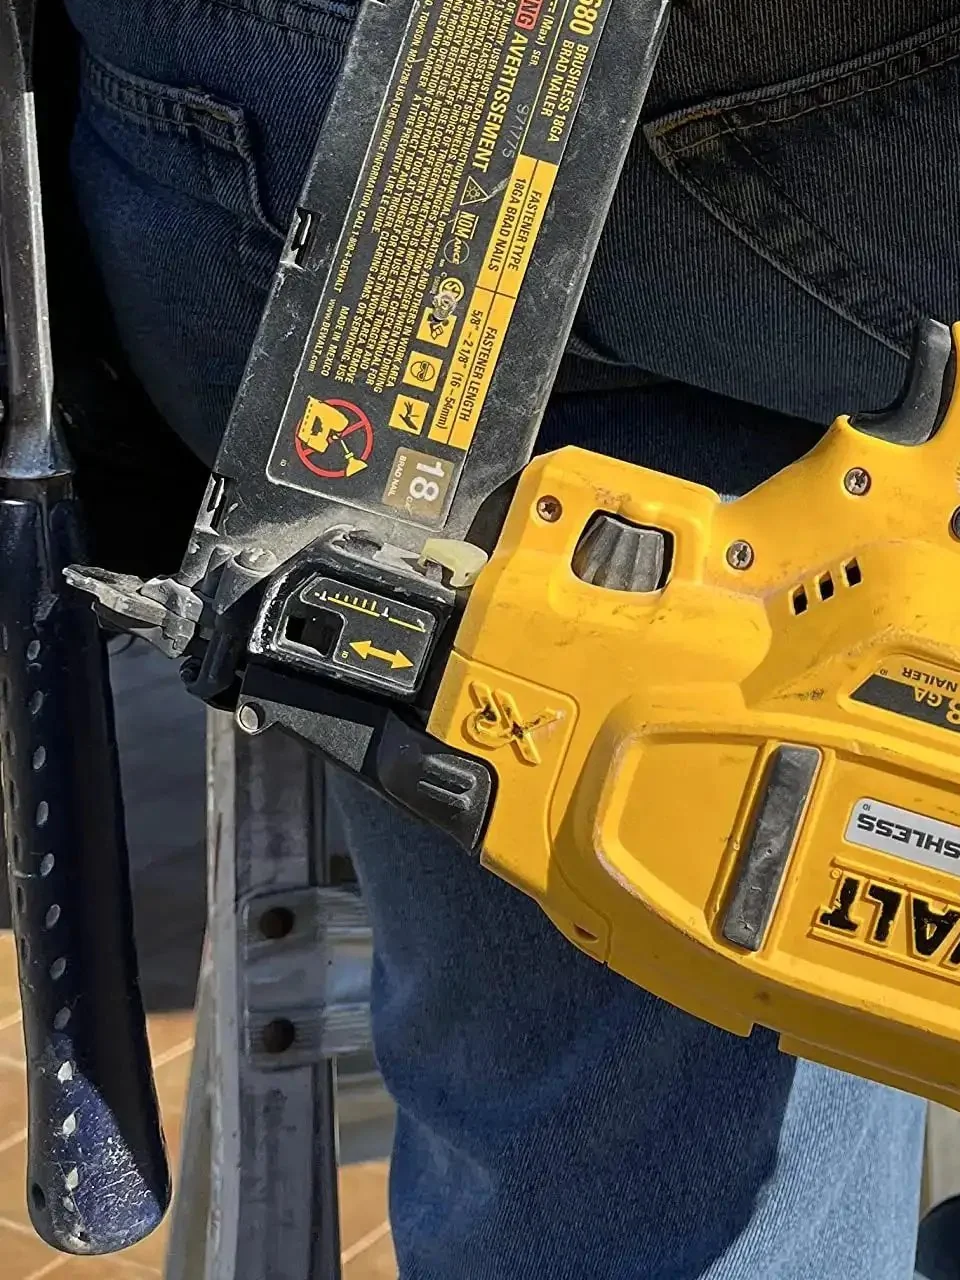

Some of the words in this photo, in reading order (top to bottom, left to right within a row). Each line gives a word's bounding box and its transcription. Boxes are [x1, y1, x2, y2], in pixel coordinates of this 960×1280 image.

[451, 2, 472, 45] PROPERLY
[468, 0, 483, 27] NEVER
[471, 0, 494, 51] ACCIDENTAL
[485, 9, 502, 41] SAFETY
[430, 26, 443, 46] AND
[440, 12, 458, 46] PROPER
[534, 14, 553, 46] (Max)
[456, 28, 474, 64] DISABLE
[473, 41, 492, 79] GLASSES
[486, 47, 500, 70] USER
[527, 49, 540, 67] SER.
[554, 39, 574, 72] BRAD
[398, 62, 412, 84] 21286
[425, 47, 447, 95] OPERATION
[441, 45, 458, 78] BEFORE
[465, 80, 480, 103] WITH
[478, 70, 493, 96] MUST
[556, 43, 588, 112] BRUSHLESS
[392, 84, 405, 102] USA
[421, 95, 432, 108] OF
[470, 31, 529, 173] AVERTISSEMENT
[540, 74, 563, 116] NAILER
[387, 102, 400, 119] FOR
[404, 101, 419, 126] TITRE
[425, 99, 441, 127] NEVER
[437, 107, 449, 124] USE
[444, 103, 461, 135] CHOICE
[459, 104, 472, 124] SIDE
[471, 97, 485, 120] READ
[377, 118, 394, 151] SERVICE
[407, 110, 427, 149] CONTACT
[416, 128, 432, 154] POINT
[440, 135, 451, 148] OF
[501, 103, 529, 159] 971775
[546, 113, 566, 143] 18GA
[424, 125, 443, 166] LOCK-OFF
[452, 120, 477, 178] INSTRUCTION
[401, 150, 414, 170] TRIP
[409, 155, 423, 178] TOOL
[424, 147, 447, 199] TRIGGERING
[439, 162, 453, 185] KEEP
[383, 175, 396, 193] LIRE
[394, 170, 408, 190] AND
[405, 178, 416, 190] AT
[415, 166, 430, 193] WHEN
[508, 177, 526, 205] 18GA
[379, 194, 390, 205] LE
[391, 190, 412, 234] YOURSELF
[408, 194, 421, 216] TOOL
[428, 184, 447, 221] FINGERS
[352, 210, 366, 230] CALL
[405, 217, 414, 226] IS
[412, 199, 431, 237] METHOD
[454, 210, 475, 238] NOM
[498, 206, 517, 236] BRAD
[516, 190, 542, 243] FASTENER
[387, 234, 398, 247] OR
[398, 227, 411, 246] NOT
[409, 237, 419, 246] IS
[419, 221, 435, 248] AWAY
[423, 220, 446, 270] OPERATORS
[332, 230, 359, 292] 1-800-4-DEWALT
[368, 230, 389, 272] CLEARING
[376, 247, 394, 281] OTHERS
[395, 246, 405, 256] IN
[411, 248, 426, 273] FROM
[452, 236, 461, 265] ANCE
[487, 238, 506, 271] NAILS
[507, 244, 524, 271] TYPE
[373, 282, 383, 293] IN
[377, 278, 395, 312] ENSURE
[399, 274, 418, 310] TRIGGER
[334, 305, 349, 331] MADE
[355, 301, 366, 314] OR
[364, 293, 380, 320] WORK
[383, 300, 399, 328] CHECK
[406, 290, 423, 325] OTHERS
[306, 297, 338, 372] www.DEWALT.com
[331, 330, 341, 341] IN
[366, 313, 384, 349] TRIGGER
[391, 310, 407, 338] WHEN
[319, 343, 337, 376] MEXICO
[359, 350, 372, 370] AND
[371, 329, 390, 367] MANUAL
[393, 336, 409, 363] WORK
[471, 327, 497, 379] FASTENER
[334, 363, 347, 381] USE
[344, 347, 363, 383] REMOVE
[365, 367, 378, 385] FOR
[373, 357, 392, 393] DRIVING
[385, 363, 400, 388] AREA
[458, 380, 480, 421] LENGTH
[393, 455, 406, 477] BRAD
[387, 478, 398, 496] NAIL
[406, 461, 447, 504] 18
[901, 666, 958, 692] NAILER
[912, 686, 942, 707] GA
